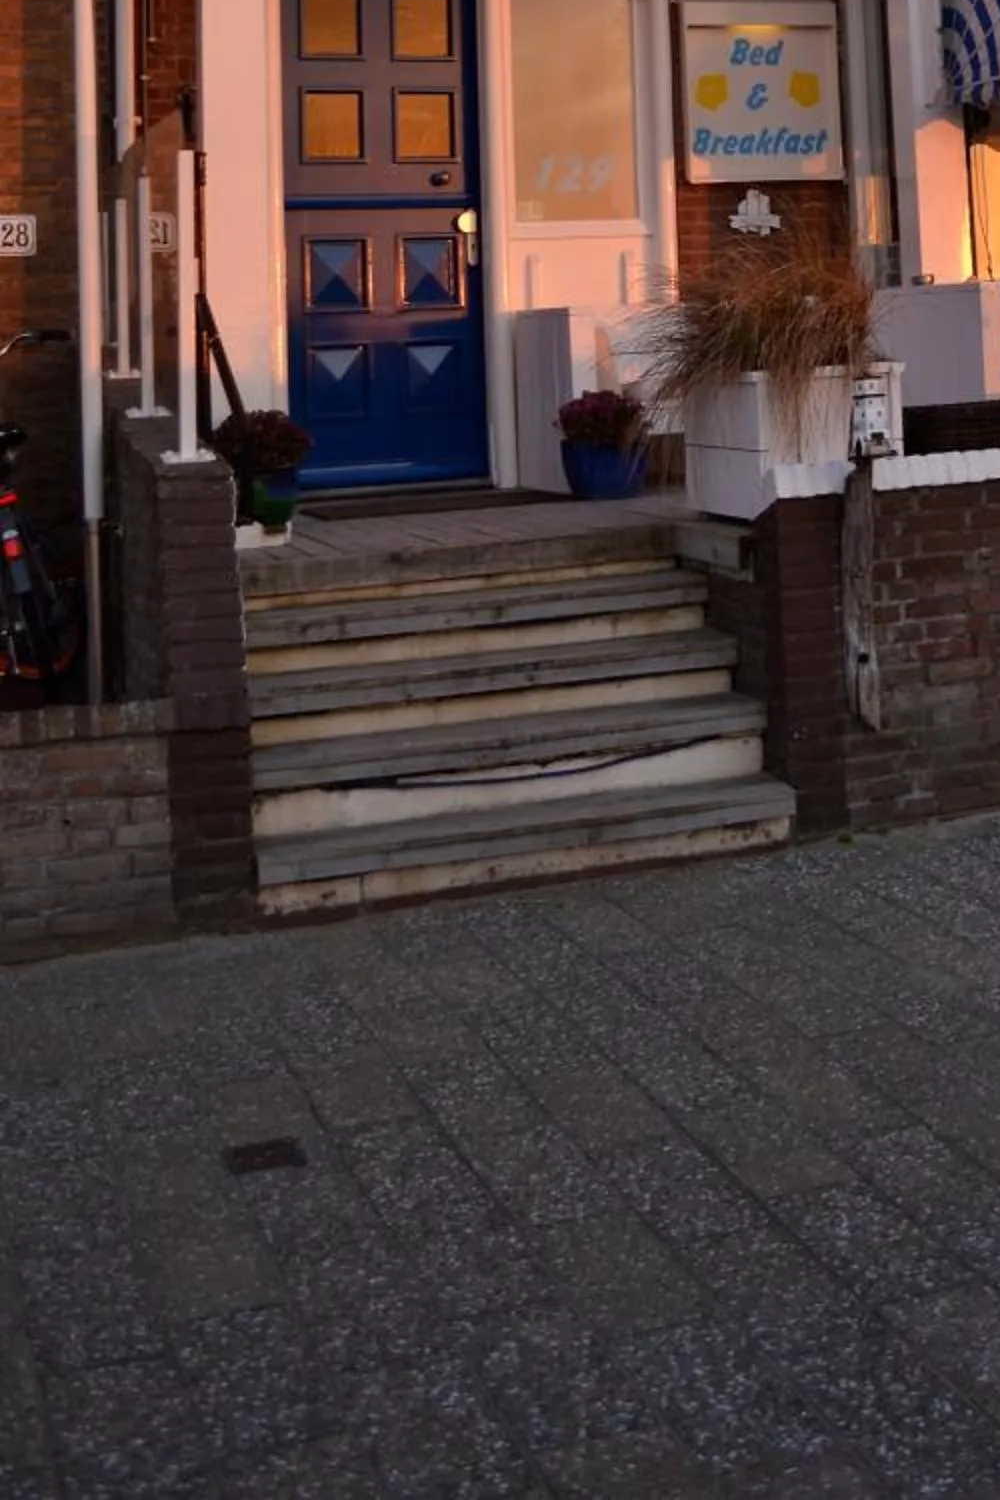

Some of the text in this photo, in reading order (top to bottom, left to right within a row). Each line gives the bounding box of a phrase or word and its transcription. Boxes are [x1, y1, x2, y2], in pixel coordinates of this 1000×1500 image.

[730, 39, 783, 66] Bed
[746, 83, 768, 110] &
[693, 127, 827, 155] Breakfast
[535, 153, 613, 194] 129
